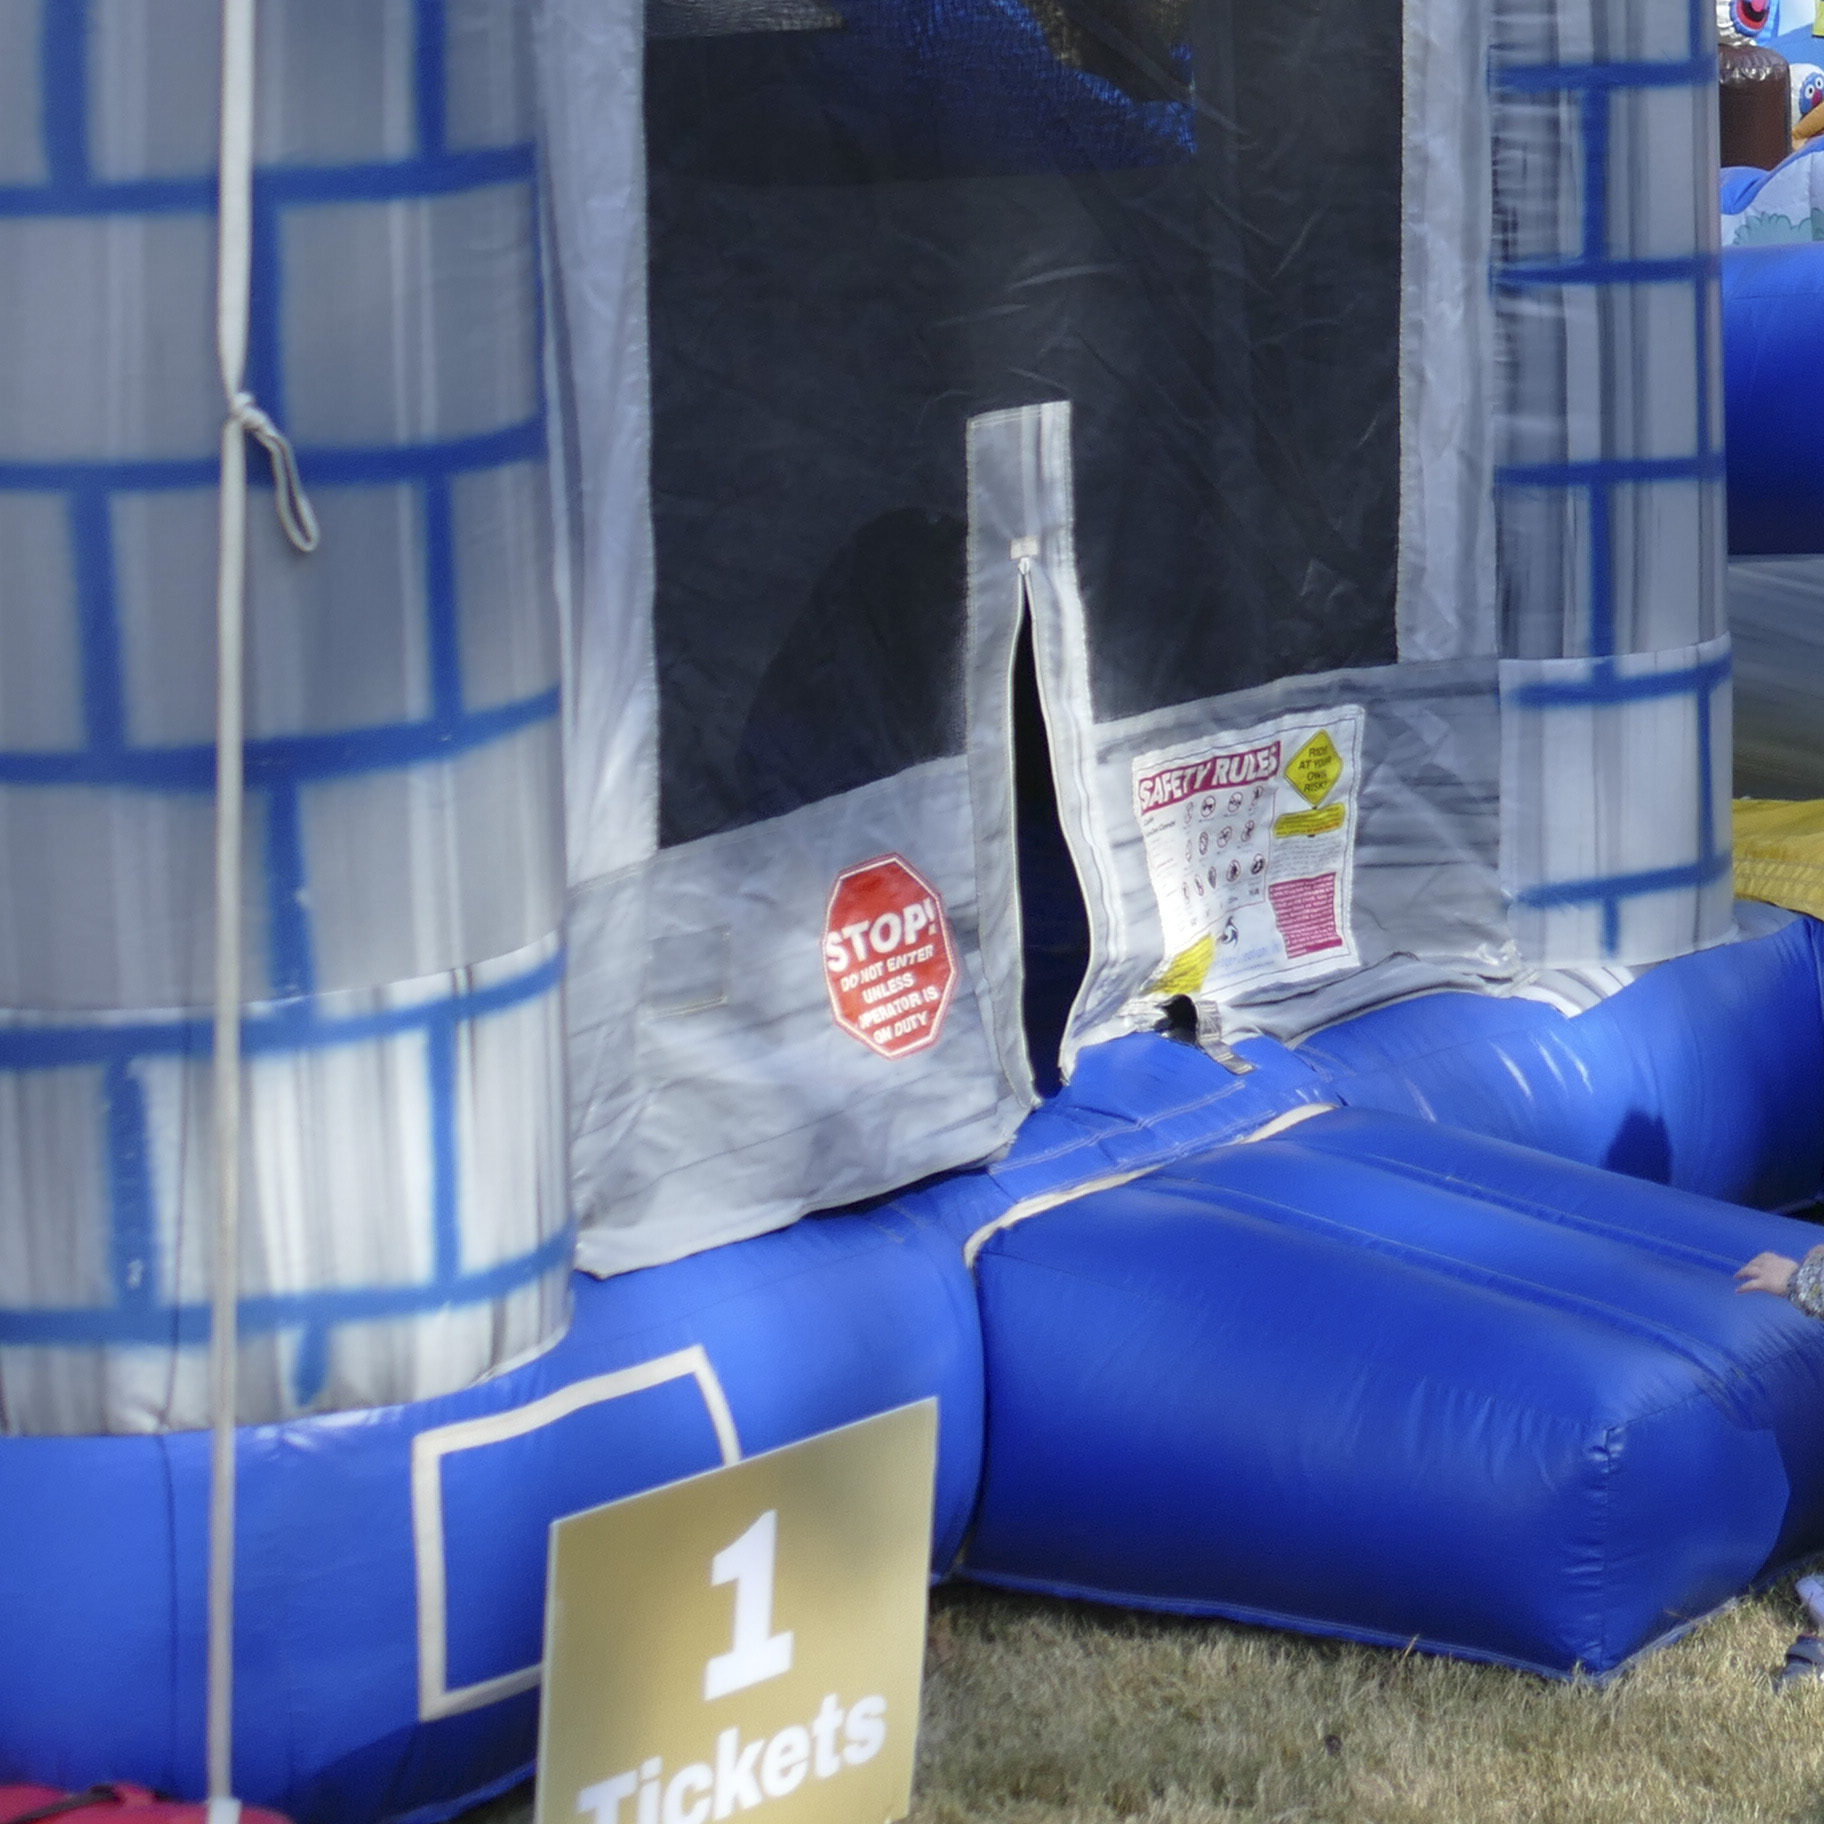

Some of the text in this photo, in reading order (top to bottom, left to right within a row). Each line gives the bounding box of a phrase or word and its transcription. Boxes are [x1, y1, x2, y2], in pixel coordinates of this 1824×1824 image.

[1139, 746, 1278, 810] SAFETY RULES
[1298, 759, 1311, 771] AT
[826, 897, 937, 972] STOP!
[840, 944, 934, 993] DO NOT ENTER
[862, 972, 915, 1004] UNLESS
[922, 985, 940, 1003] IS
[873, 1010, 929, 1044] ON DUTY
[704, 1508, 795, 1702] 1
[577, 1692, 888, 1824] Tickets
